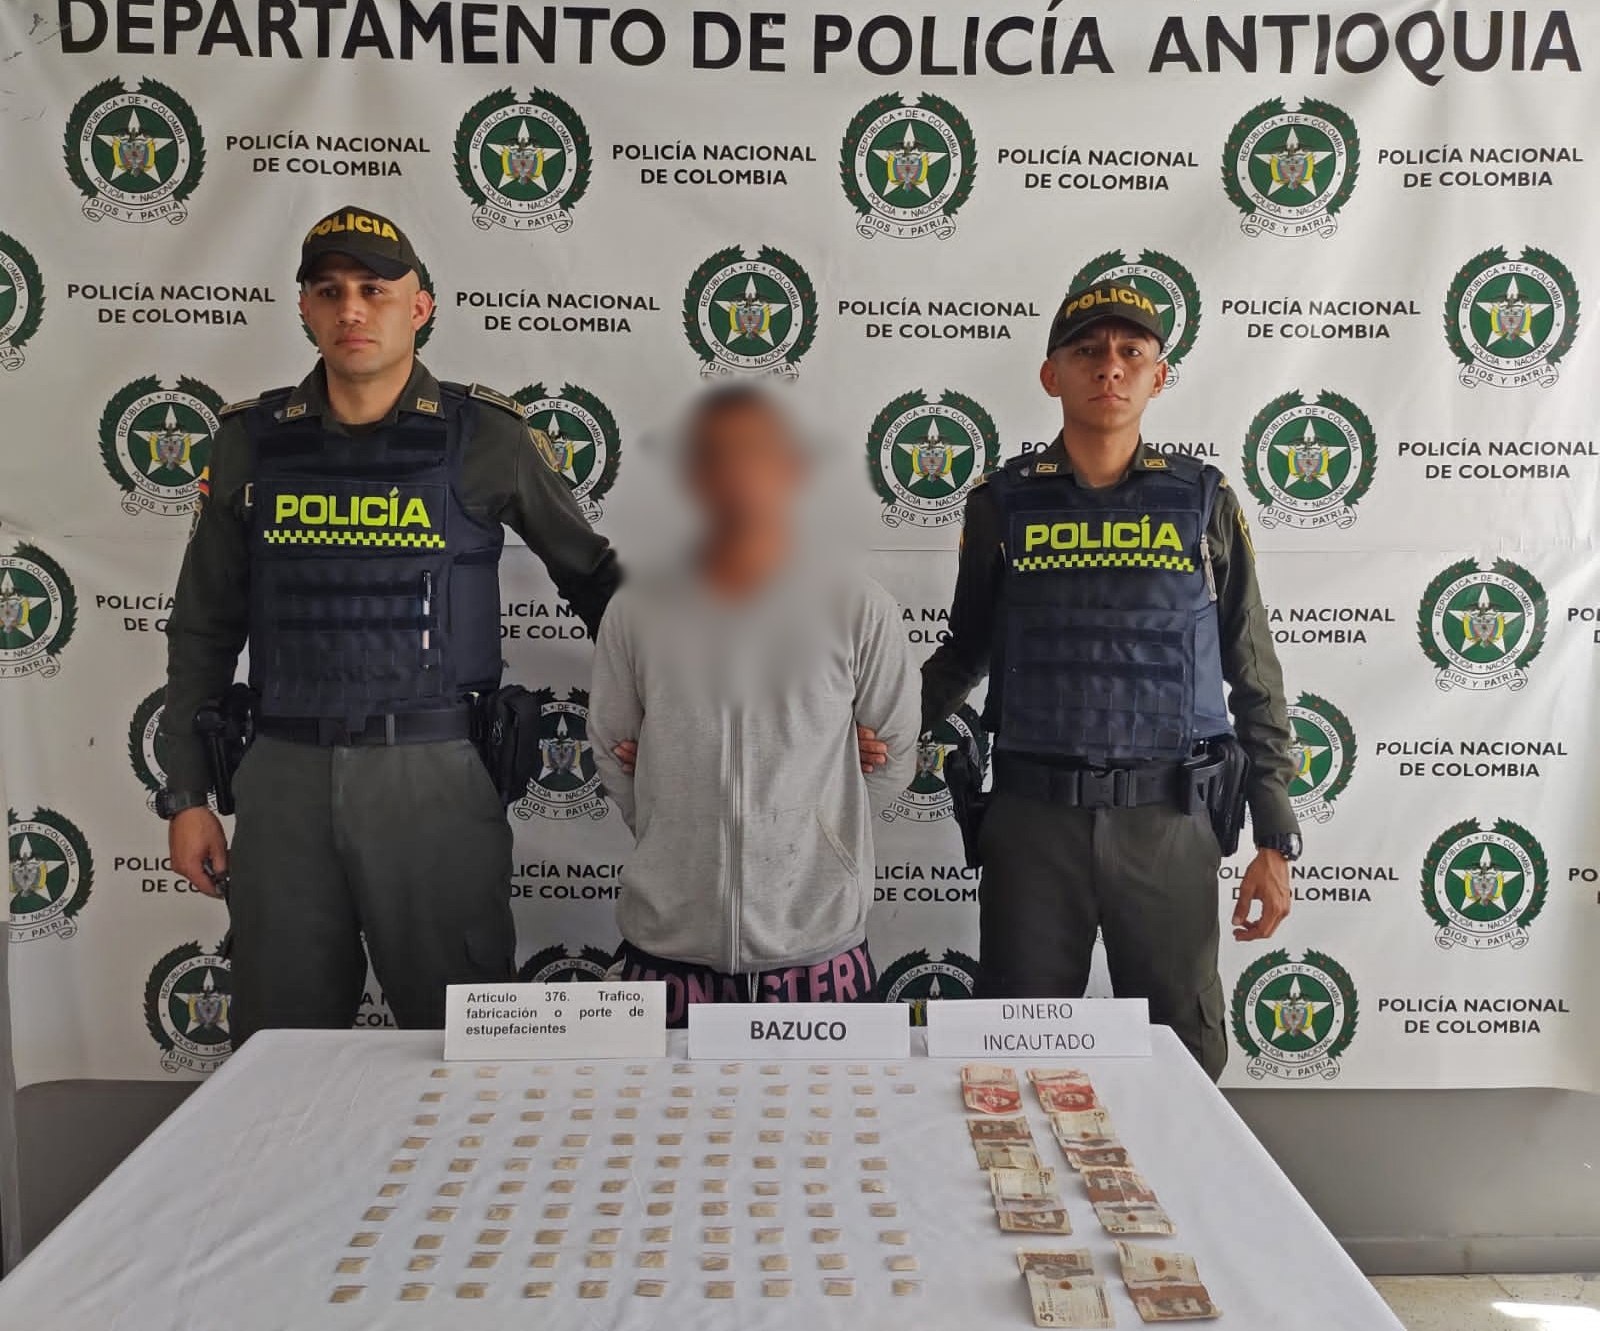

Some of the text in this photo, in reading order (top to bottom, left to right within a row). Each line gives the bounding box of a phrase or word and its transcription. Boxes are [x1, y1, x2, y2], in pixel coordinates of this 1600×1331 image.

[59, 0, 1581, 86] DEPARTAMENTO DE POLICÍA ANTIOQUIA
[128, 96, 142, 104] DE
[152, 102, 186, 144] COLOMBIA
[519, 106, 532, 114] DE
[541, 112, 574, 154] COLOMBIA
[905, 110, 918, 118] DE
[928, 115, 959, 158] COLOMBIA
[227, 130, 430, 152] POLICÍA NACIONAL
[613, 141, 816, 161] POLICÍA NACIONAL
[998, 145, 1198, 167] POLICÍA NACIONAL
[1379, 145, 1583, 164] POLICÍA NACIONAL
[253, 158, 402, 176] DE COLOMBIA
[641, 169, 787, 185] DE COLOMBIA
[1025, 174, 1168, 190] DE COLOMBIA
[1404, 172, 1552, 188] DE COLOMBIA
[92, 199, 119, 216] DIOS
[141, 203, 180, 220] PATRIA
[481, 207, 507, 224] DIOS
[528, 211, 566, 228] PATRIA
[865, 216, 890, 232] DIOS
[912, 217, 949, 236] PATRIA
[68, 282, 275, 302] POLICÍA NACIONAL
[769, 269, 800, 309] COLOMBIA
[1509, 264, 1522, 272] DE
[1531, 269, 1562, 309] COLOMBIA
[457, 289, 660, 310] POLICÍA NACIONAL
[839, 297, 1040, 316] POLICÍA NACIONAL
[1222, 297, 1420, 315] POLICÍA NACIONAL
[99, 309, 247, 325] DE COLOMBIA
[485, 316, 631, 332] DE COLOMBIA
[867, 324, 1011, 339] DE COLOMBIA
[1248, 324, 1390, 338] DE COLOMBIA
[1468, 366, 1493, 381] DIOS
[1515, 366, 1552, 384] PATRIA
[1305, 407, 1318, 415] DE
[1328, 412, 1359, 452] COLOMBIA
[1399, 438, 1598, 456] POLICÍA NACIONAL
[1426, 465, 1570, 478] DE COLOMBIA
[275, 487, 431, 528] POLICÍA
[1267, 507, 1292, 522] DIOS
[1313, 508, 1350, 525] PATRIA
[1025, 515, 1183, 552] POLICÍA
[96, 593, 175, 610] POLICÍA
[124, 618, 148, 631] DE
[1290, 609, 1395, 622] NACIONAL
[1275, 630, 1366, 643] OLOMBIA
[1376, 738, 1567, 755] POLICÍA NACIONAL
[1400, 763, 1539, 777] DE COLOMBIA
[522, 799, 546, 813] DIOS
[566, 799, 602, 816] PATRIA
[114, 857, 171, 871] POLIC
[567, 864, 624, 878] NACI
[874, 862, 924, 880] LICÍA
[1292, 866, 1399, 880] NACIONAL
[142, 879, 168, 893] DE
[874, 888, 977, 902] DE COLOM
[1295, 888, 1371, 901] LOMBIA
[1443, 928, 1467, 943] DIOS
[1488, 929, 1523, 946] PATRIA
[467, 1008, 537, 1018] fabricación
[580, 1008, 612, 1020] porte
[629, 1006, 644, 1017] de
[1002, 1003, 1073, 1020] DINERO
[1379, 996, 1570, 1013] POLICÍA NACIONAL
[466, 1023, 566, 1037] estupefacientes
[751, 1021, 846, 1041] BAZUCO
[1405, 1020, 1540, 1033] DE COLOMBIA
[984, 1034, 1094, 1050] INCAUTADO
[1255, 1058, 1278, 1073] DIOS
[1298, 1059, 1333, 1076] PATRIA
